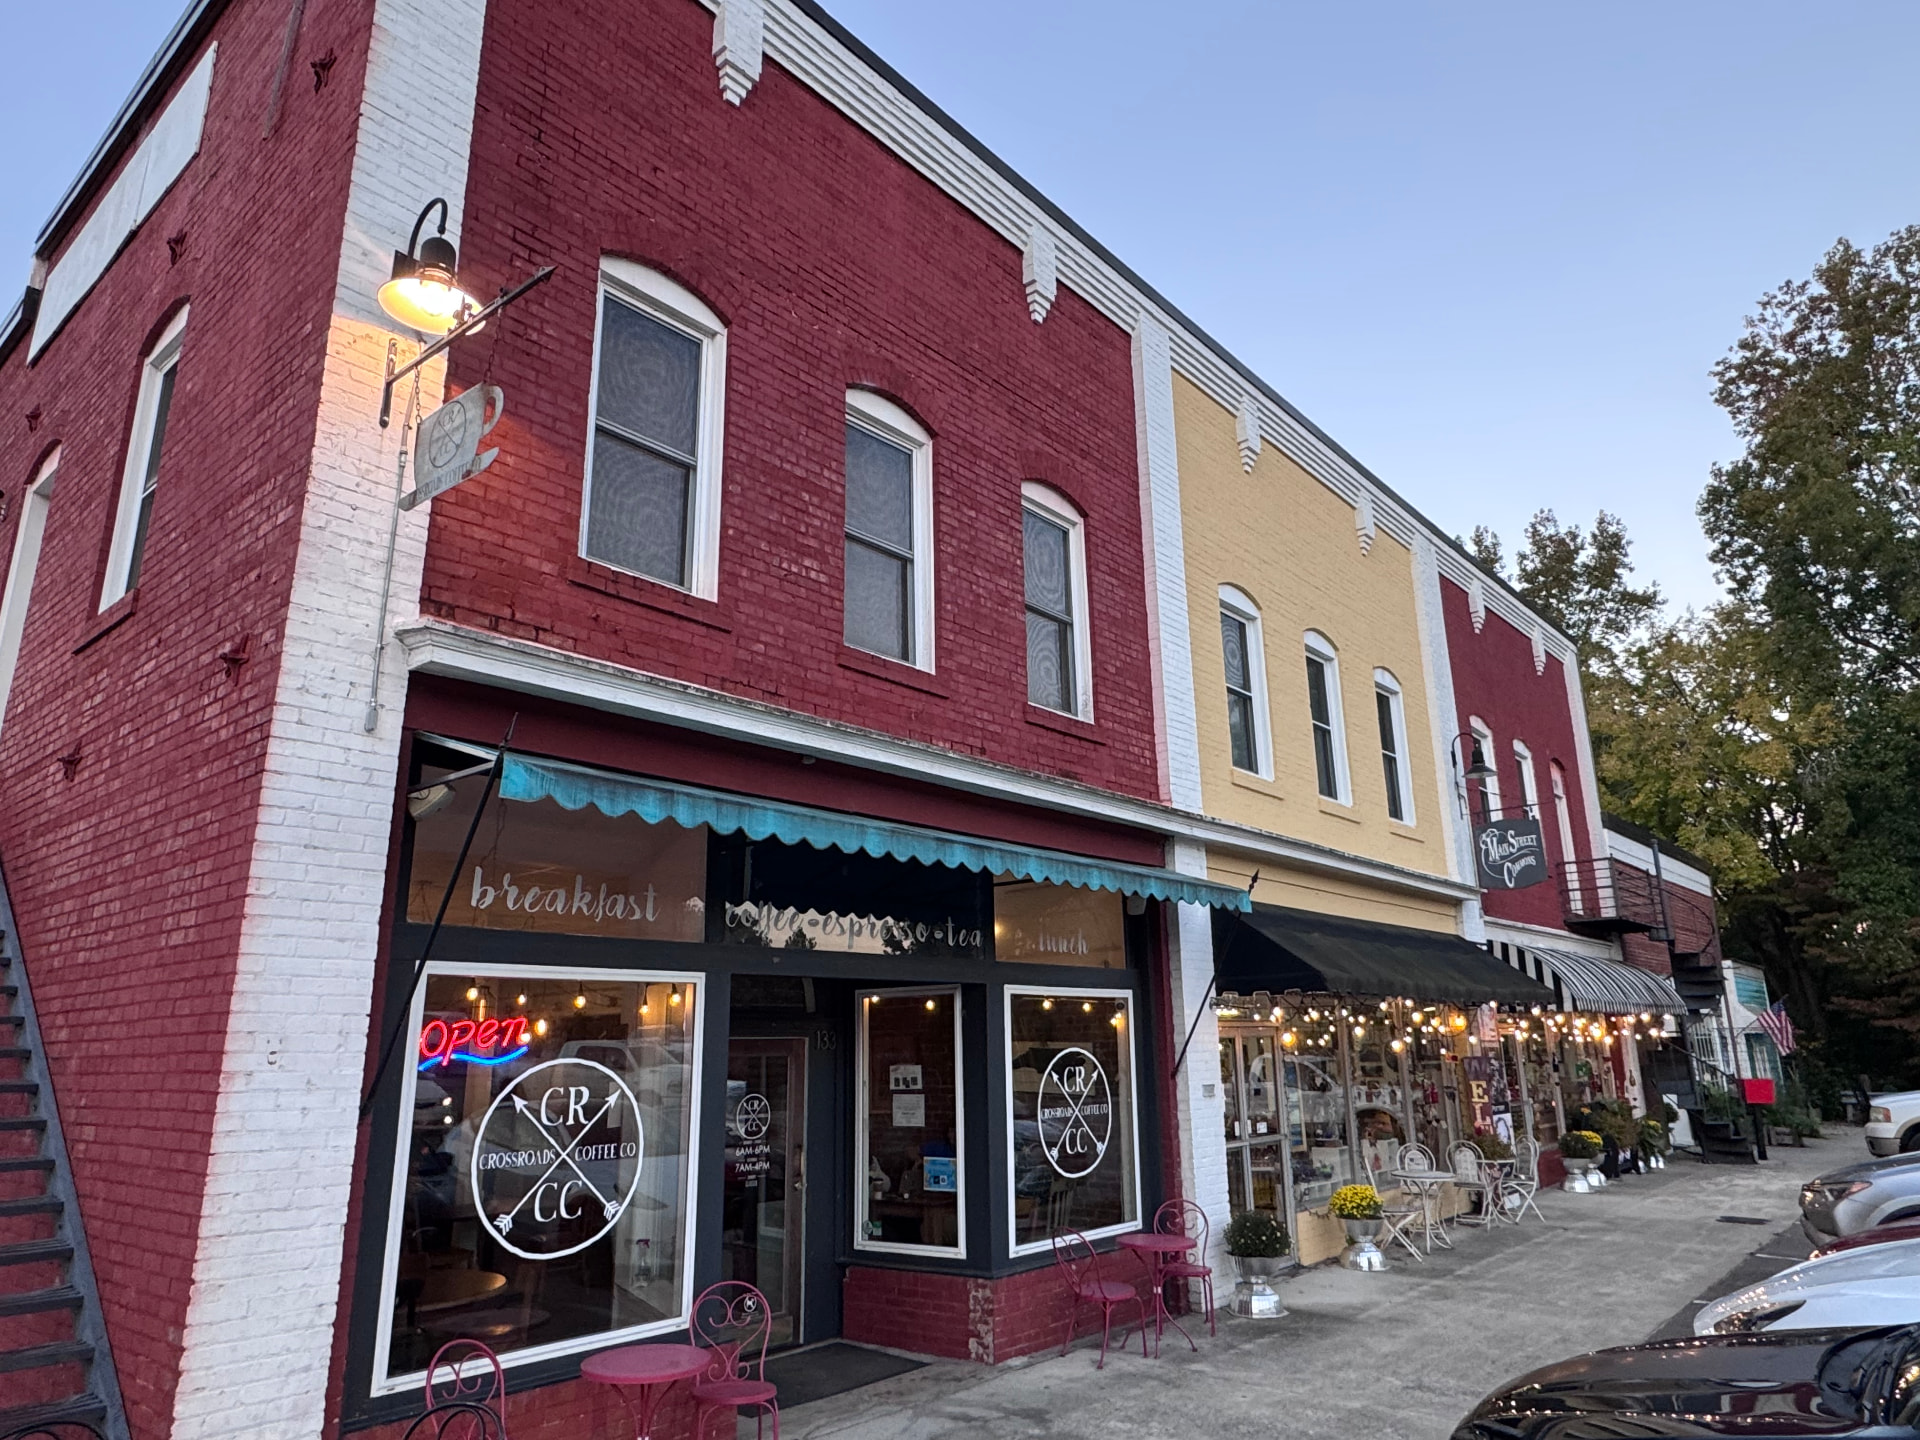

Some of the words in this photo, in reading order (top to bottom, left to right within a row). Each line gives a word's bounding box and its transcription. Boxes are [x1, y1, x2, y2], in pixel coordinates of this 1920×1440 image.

[471, 866, 660, 922] breakfast
[725, 900, 802, 937] coffee
[822, 913, 931, 950] espresso
[946, 916, 983, 948] tea
[816, 1030, 837, 1050] 133
[1063, 1066, 1087, 1093] CR
[540, 1085, 590, 1126] CR
[748, 1100, 759, 1111] CR
[1040, 1106, 1074, 1120] CROSSROADS
[1080, 1104, 1100, 1117] COFFEE
[1100, 1103, 1108, 1114] CO
[735, 1145, 770, 1157] 6AM-6PM
[1065, 1127, 1088, 1154] CC
[479, 1148, 556, 1170] CROSSROADS
[575, 1143, 617, 1161] COFFEE
[620, 1142, 636, 1157] CO
[735, 1161, 770, 1173] 7AM-4PM
[534, 1180, 582, 1222] CC
